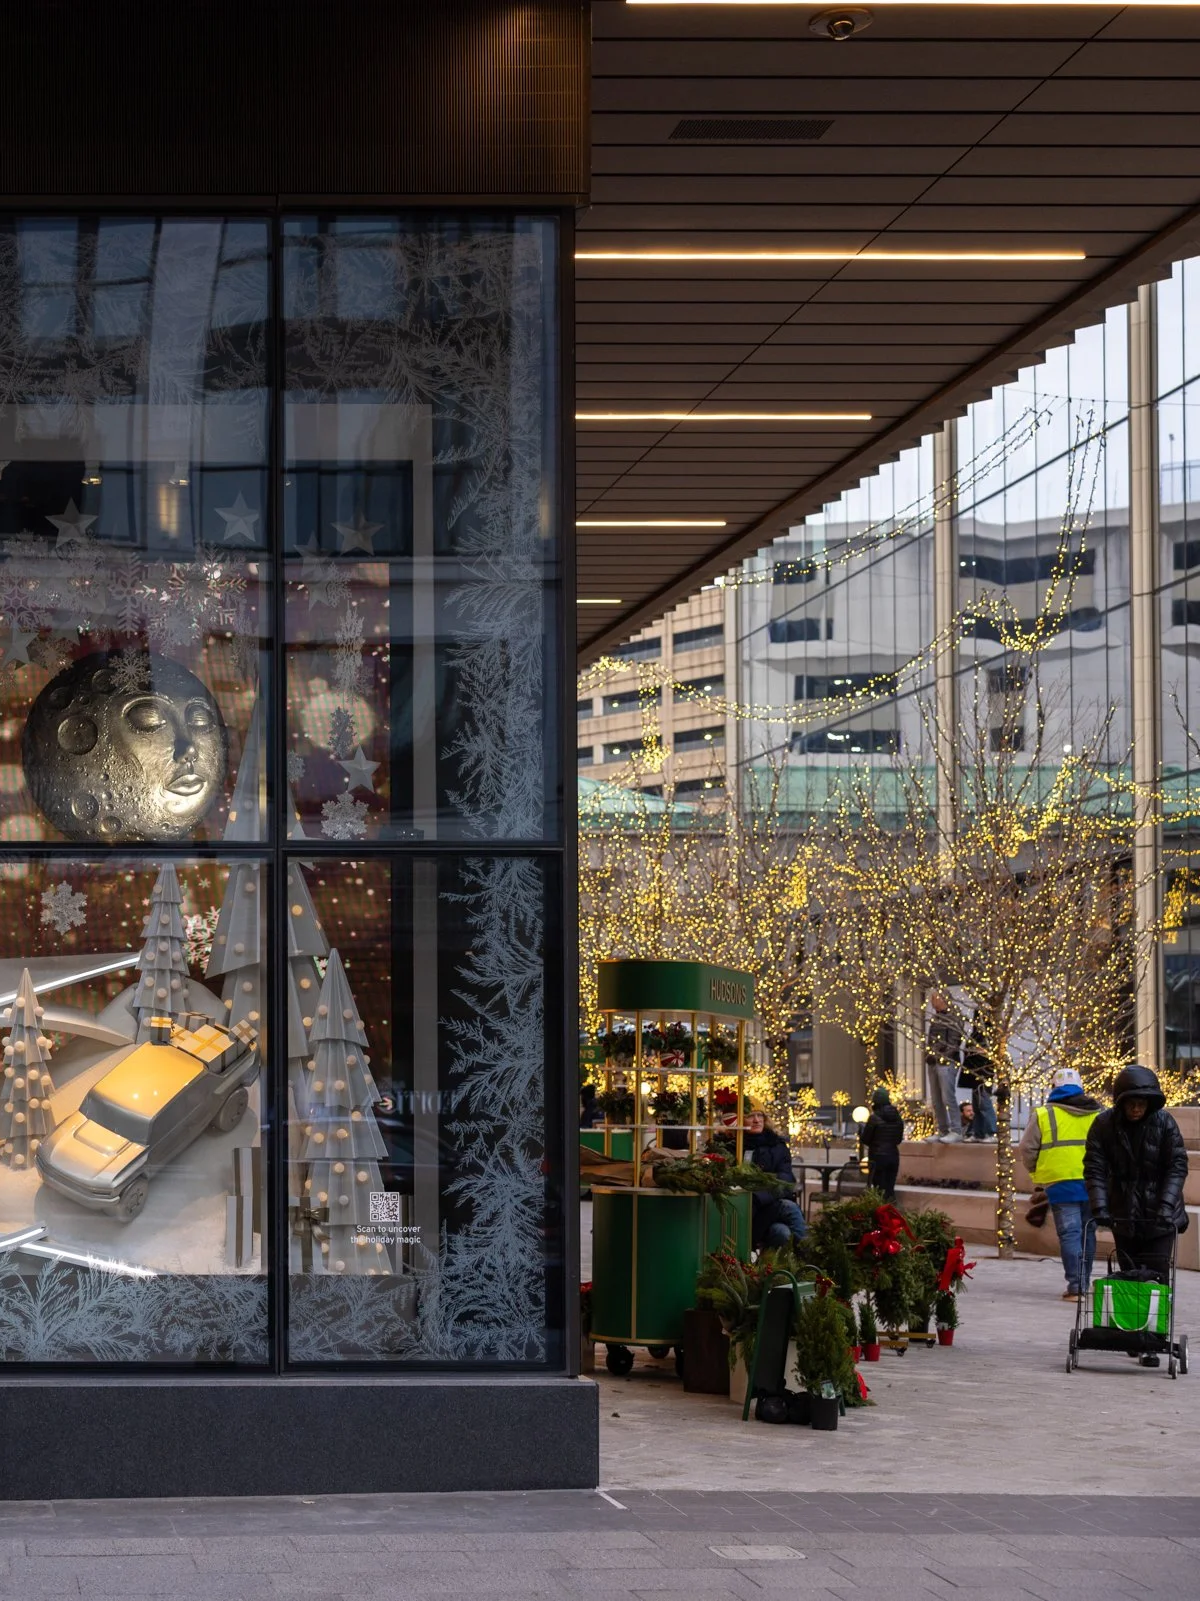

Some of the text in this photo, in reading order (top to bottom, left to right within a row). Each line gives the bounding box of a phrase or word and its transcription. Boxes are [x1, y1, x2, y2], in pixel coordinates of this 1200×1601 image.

[356, 1224, 376, 1233] Scan
[378, 1225, 387, 1233] to
[366, 1236, 394, 1245] holiday
[396, 1236, 421, 1245] magic
